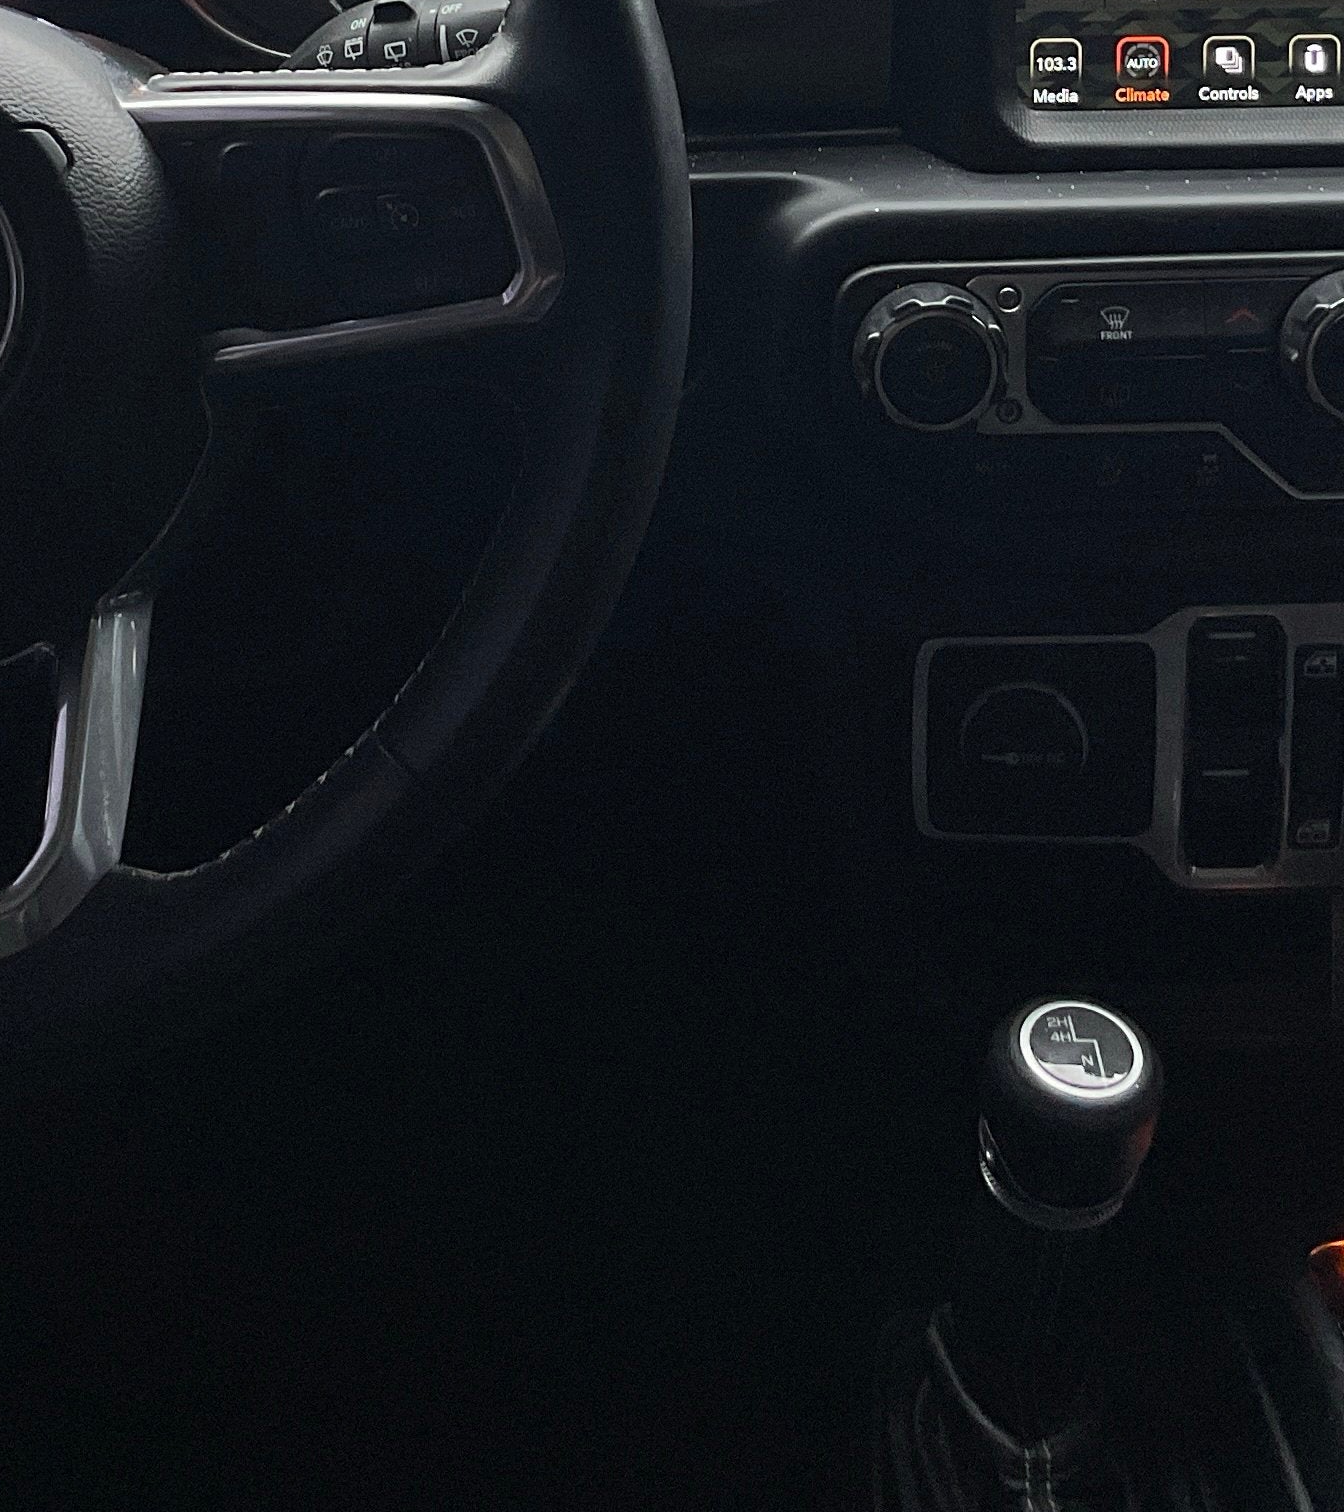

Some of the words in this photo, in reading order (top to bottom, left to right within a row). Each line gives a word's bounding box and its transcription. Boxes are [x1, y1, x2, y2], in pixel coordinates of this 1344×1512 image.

[441, 3, 463, 15] OFF
[350, 18, 367, 30] ON
[1036, 56, 1077, 72] 103.3
[1126, 57, 1158, 70] AUTO
[1033, 88, 1079, 104] Media
[1115, 87, 1170, 103] Climate
[1198, 86, 1260, 102] Controls
[1295, 85, 1334, 102] Apps
[1099, 329, 1133, 341] FRONT
[1046, 1016, 1068, 1028] 2H
[1050, 1031, 1072, 1043] 4H
[1081, 1052, 1095, 1067] N
